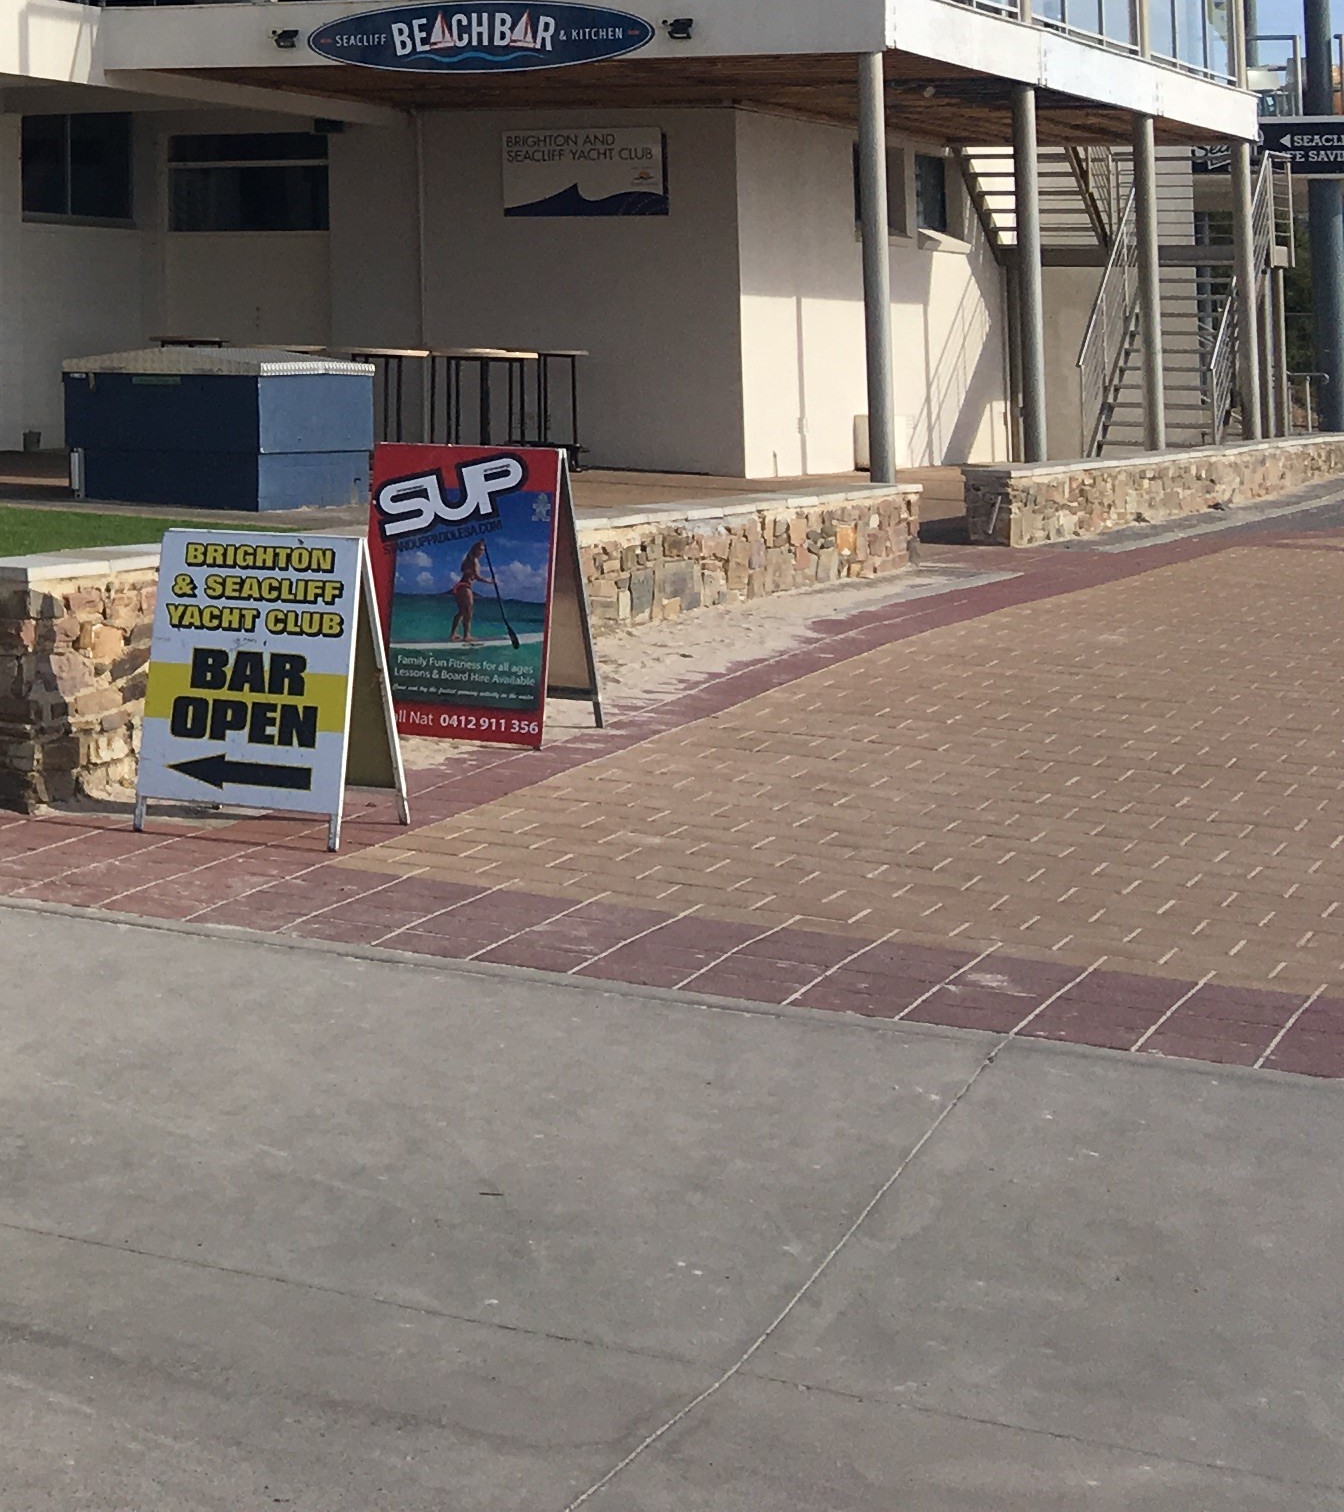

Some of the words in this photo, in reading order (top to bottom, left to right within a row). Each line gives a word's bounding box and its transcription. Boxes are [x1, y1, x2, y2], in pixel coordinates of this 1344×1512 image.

[335, 33, 387, 47] SEACLIFF
[391, 8, 556, 56] BEACHBAR
[559, 29, 567, 41] &
[571, 27, 624, 41] KITCHEN
[506, 134, 579, 148] BRIGHTON
[583, 133, 616, 146] AND
[506, 149, 565, 163] SEACLIFF
[570, 148, 615, 161] YACHT
[618, 147, 654, 160] CLUB
[377, 456, 524, 537] SUP
[185, 542, 336, 574] BRIGHTON
[172, 573, 198, 598] &
[204, 574, 344, 605] SEACLIFF
[166, 603, 260, 633] YACHT
[265, 609, 344, 638] CLUB
[190, 647, 308, 697] BAR
[394, 667, 430, 678] Lessons
[432, 669, 439, 679] &
[441, 670, 469, 681] Board
[470, 673, 490, 683] Hire
[492, 674, 536, 686] Available
[397, 654, 427, 666] Family
[429, 657, 447, 668] Fun
[448, 658, 481, 670] Fitness
[482, 660, 497, 671] for
[498, 662, 509, 673] all
[511, 665, 534, 676] ages
[170, 695, 319, 749] OPEN
[409, 711, 433, 725] Nat
[440, 714, 476, 729] 0412
[480, 717, 505, 732] 911
[510, 720, 539, 734] 356
